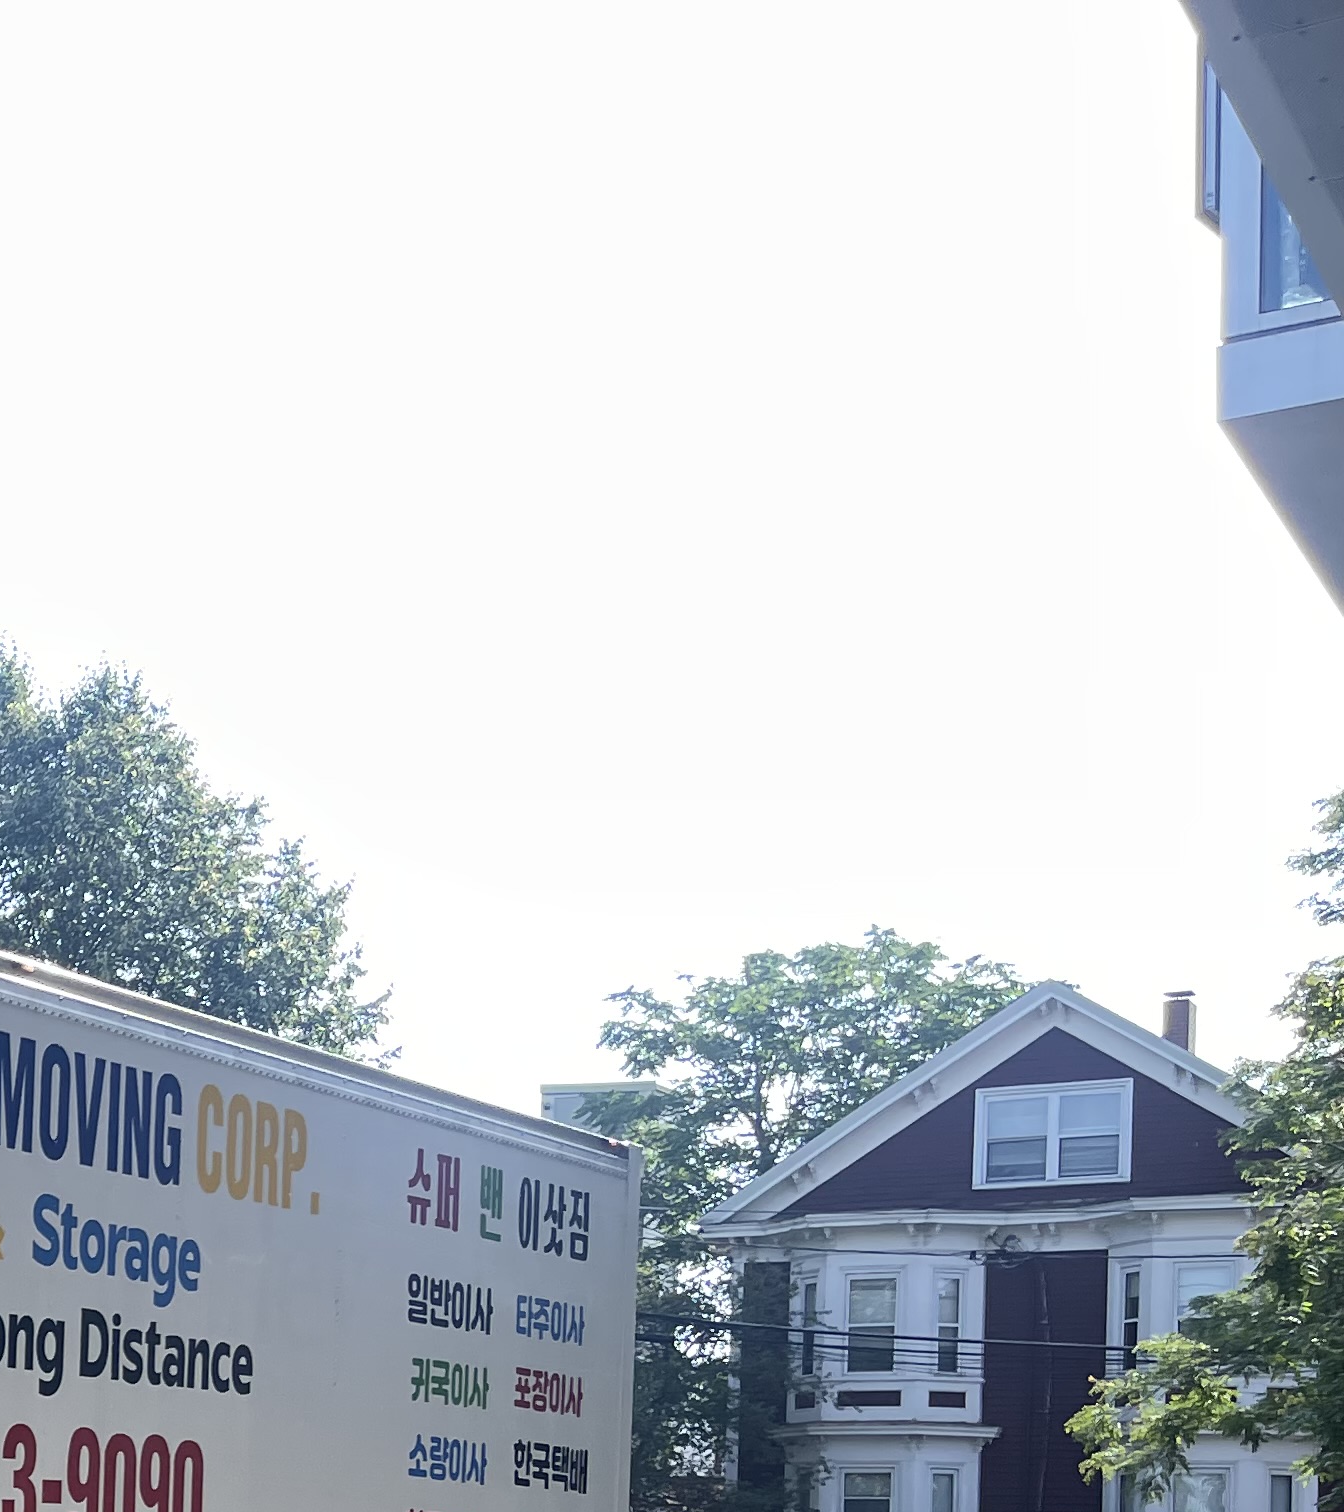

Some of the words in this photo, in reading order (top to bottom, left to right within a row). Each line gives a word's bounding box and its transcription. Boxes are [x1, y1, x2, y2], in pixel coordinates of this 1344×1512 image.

[197, 1083, 320, 1215] CORP.
[407, 1148, 460, 1232] 슈퍼
[480, 1165, 503, 1242] 밴
[519, 1177, 589, 1261] 이삿짐
[32, 1193, 201, 1307] Storage
[79, 1309, 253, 1395] Distance
[408, 1273, 493, 1335] 일반이사
[516, 1295, 584, 1346] 타주이사
[411, 1357, 489, 1409] 귀국이사
[514, 1367, 583, 1417] 포장이사
[408, 1433, 487, 1485] 소량이사
[513, 1439, 588, 1494] 한국택배
